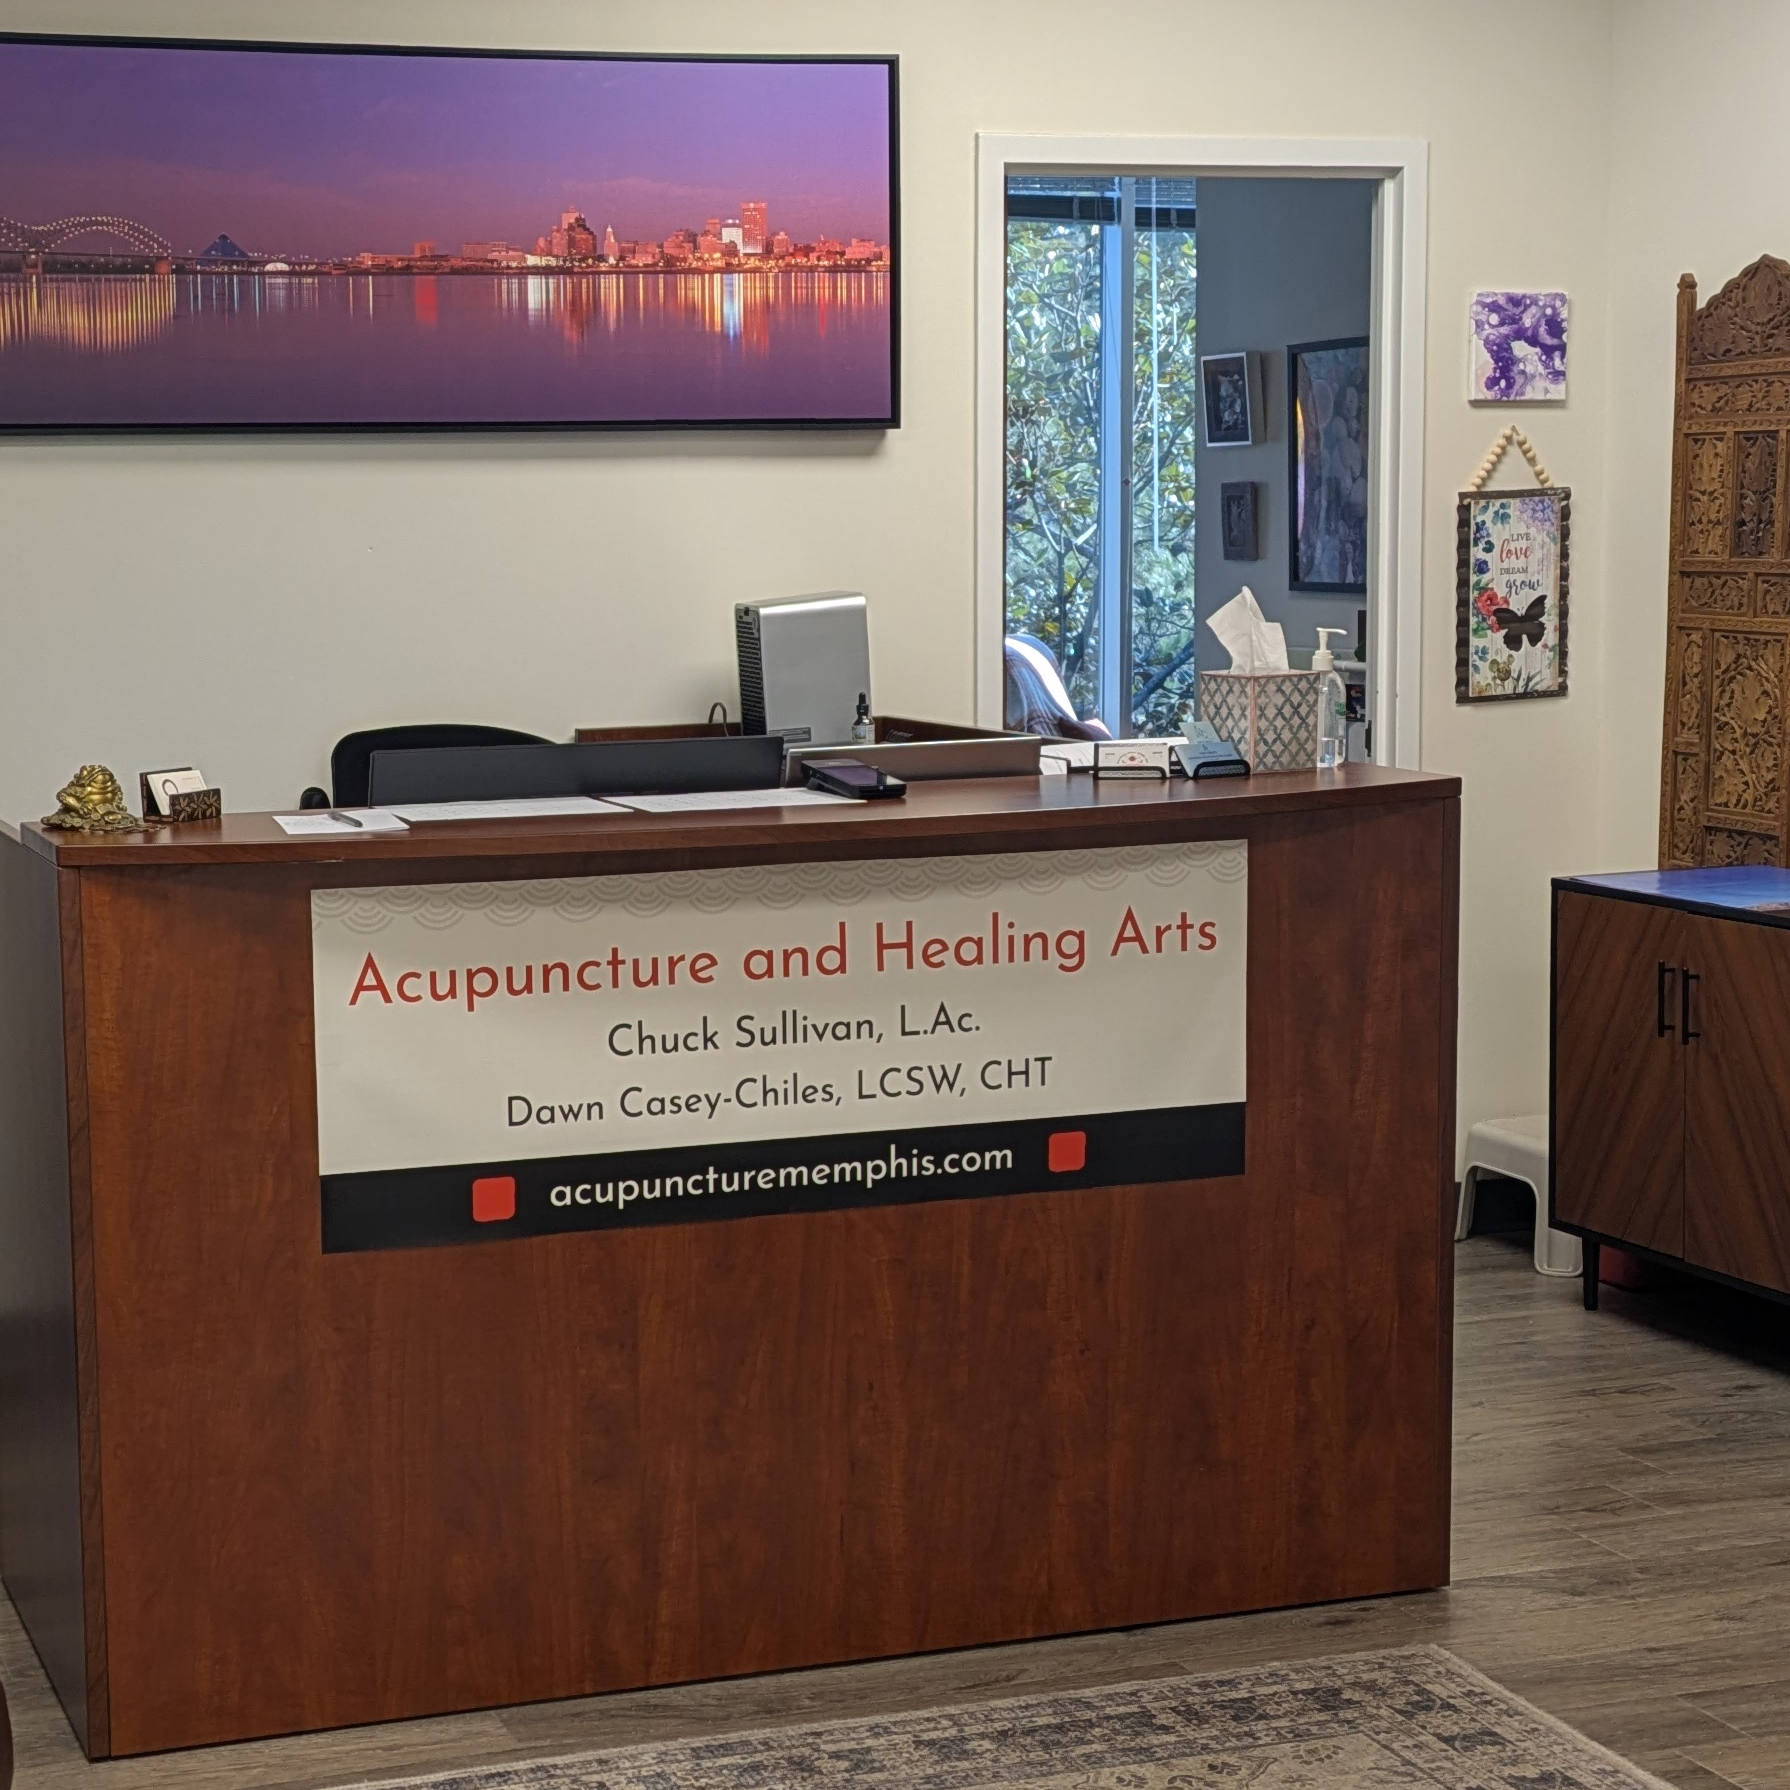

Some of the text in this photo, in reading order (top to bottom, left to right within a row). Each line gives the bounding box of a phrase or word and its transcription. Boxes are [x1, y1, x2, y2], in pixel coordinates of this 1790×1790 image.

[1500, 538, 1532, 563] love
[1511, 533, 1531, 542] LIVE
[1500, 566, 1528, 575] DREAM
[1505, 578, 1542, 599] grow
[349, 905, 1217, 1012] Acupuncture and Healing Arts
[608, 1001, 981, 1057] Chuck Sullivan, L.Ac.
[507, 1056, 1053, 1127] Dawn Casey-Chiles, LCSW, CHT
[549, 1143, 1014, 1210] acupuncturememphis.com
